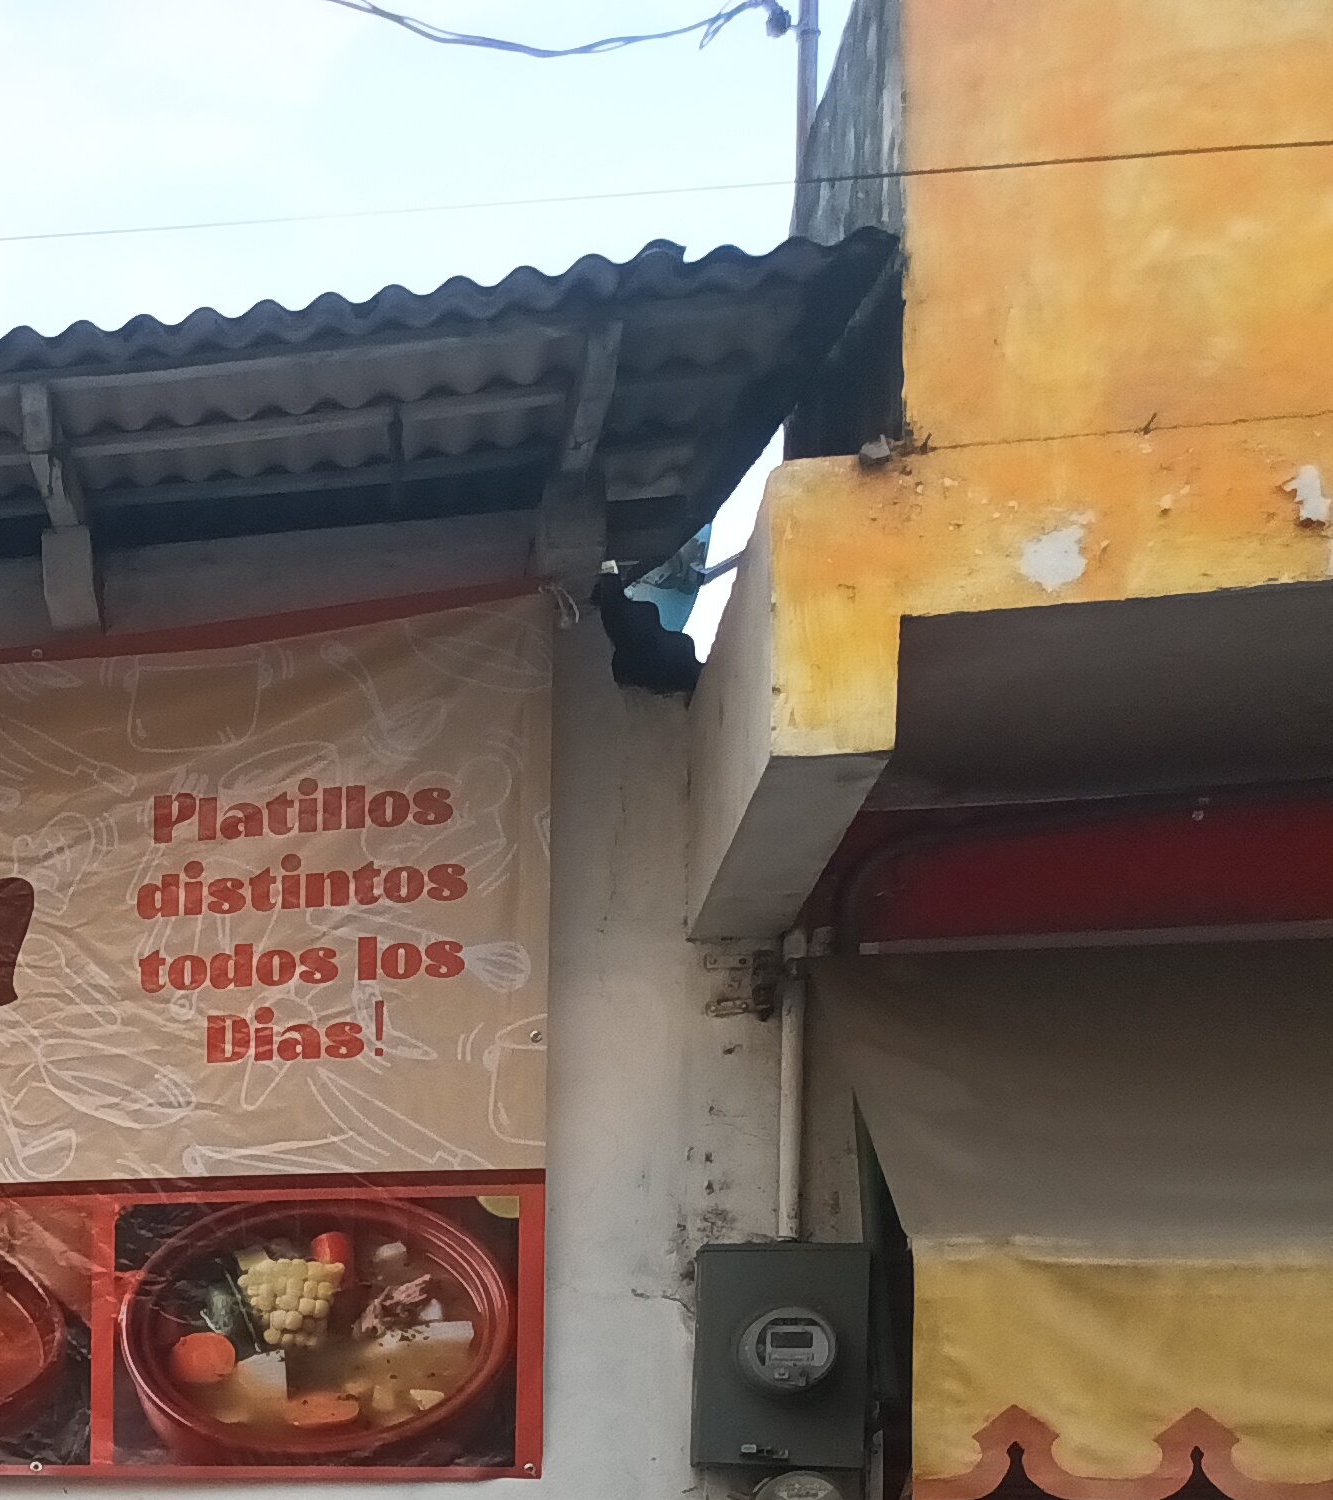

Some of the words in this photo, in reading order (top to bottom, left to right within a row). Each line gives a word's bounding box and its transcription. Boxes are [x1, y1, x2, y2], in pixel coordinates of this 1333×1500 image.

[153, 778, 453, 844] Platillos
[136, 854, 468, 919] distintos
[138, 943, 339, 993] todos
[357, 936, 466, 981] los
[206, 1000, 385, 1064] Dias!
